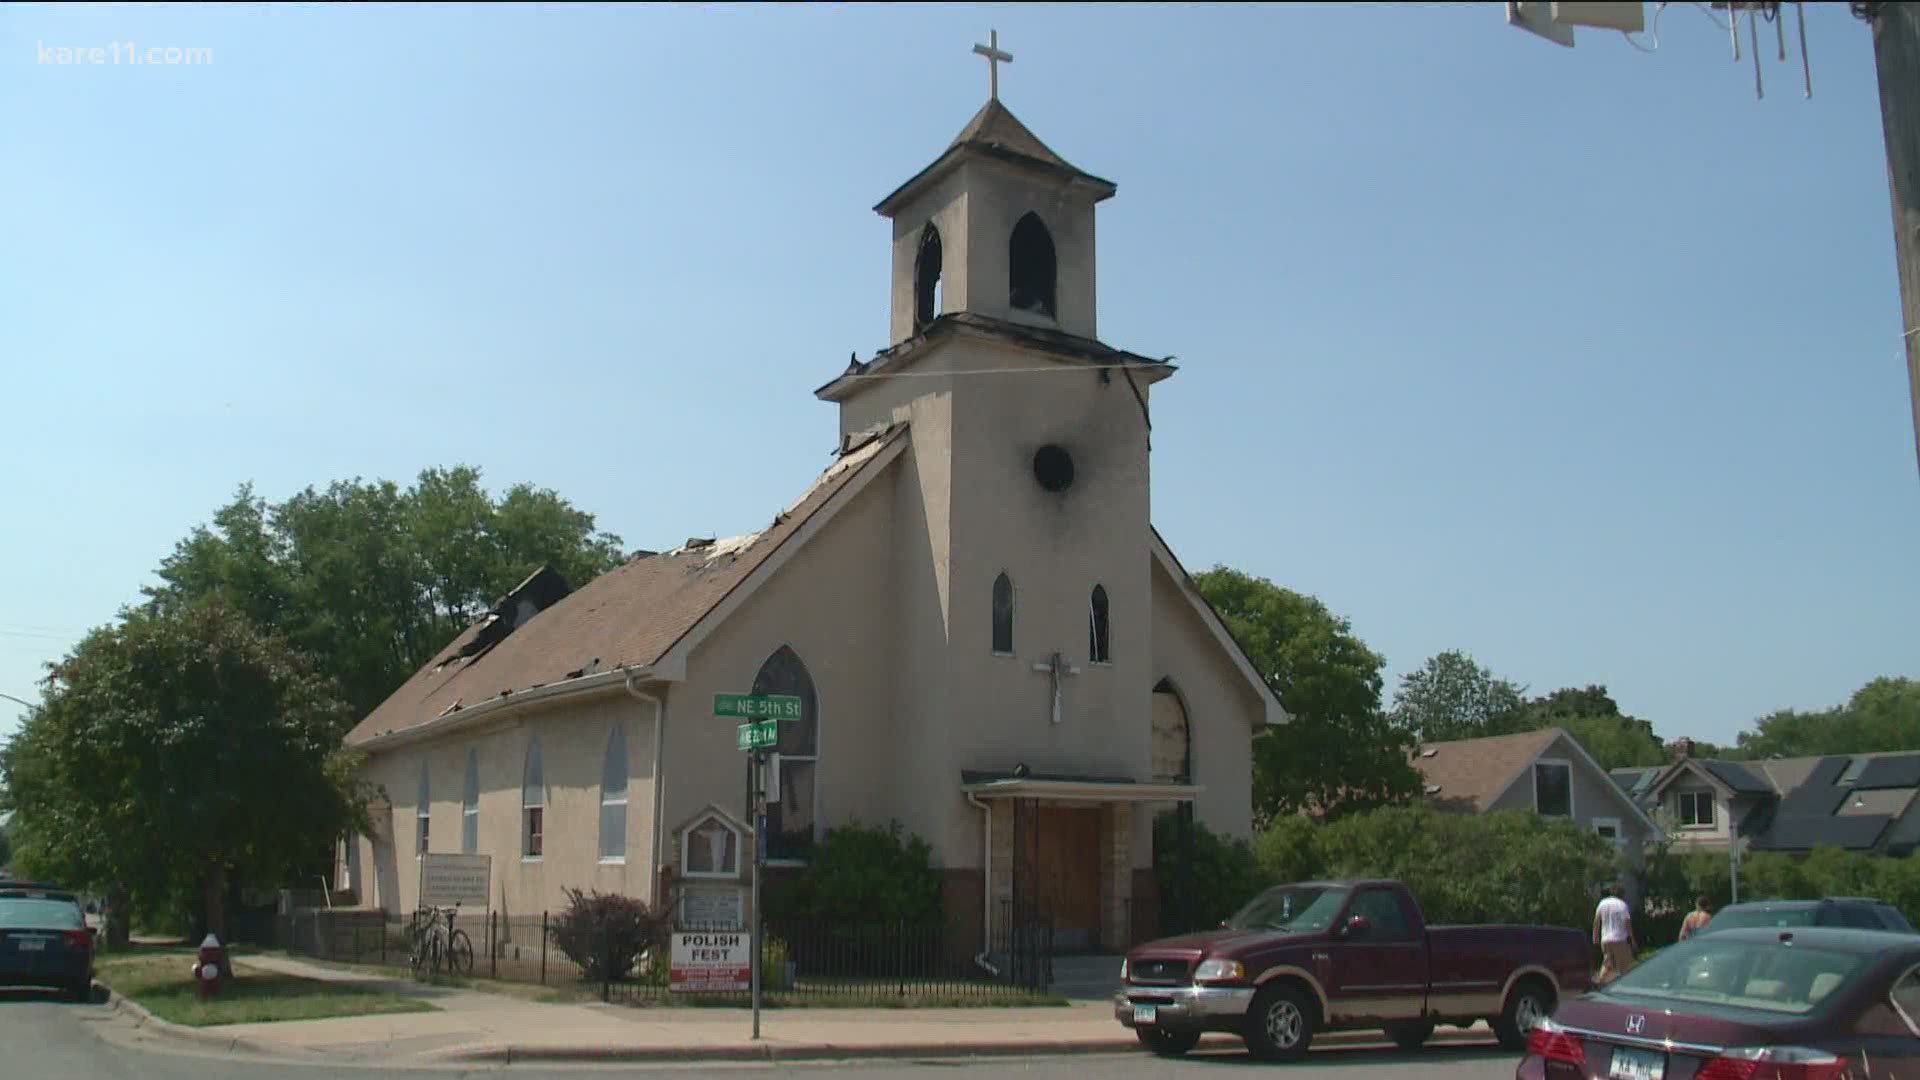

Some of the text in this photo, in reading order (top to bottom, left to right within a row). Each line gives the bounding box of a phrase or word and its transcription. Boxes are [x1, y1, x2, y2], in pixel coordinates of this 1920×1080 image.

[737, 699, 755, 713] NE
[759, 700, 781, 715] 5th
[785, 702, 800, 716] St
[682, 935, 740, 947] POLISH
[692, 949, 730, 961] FEST
